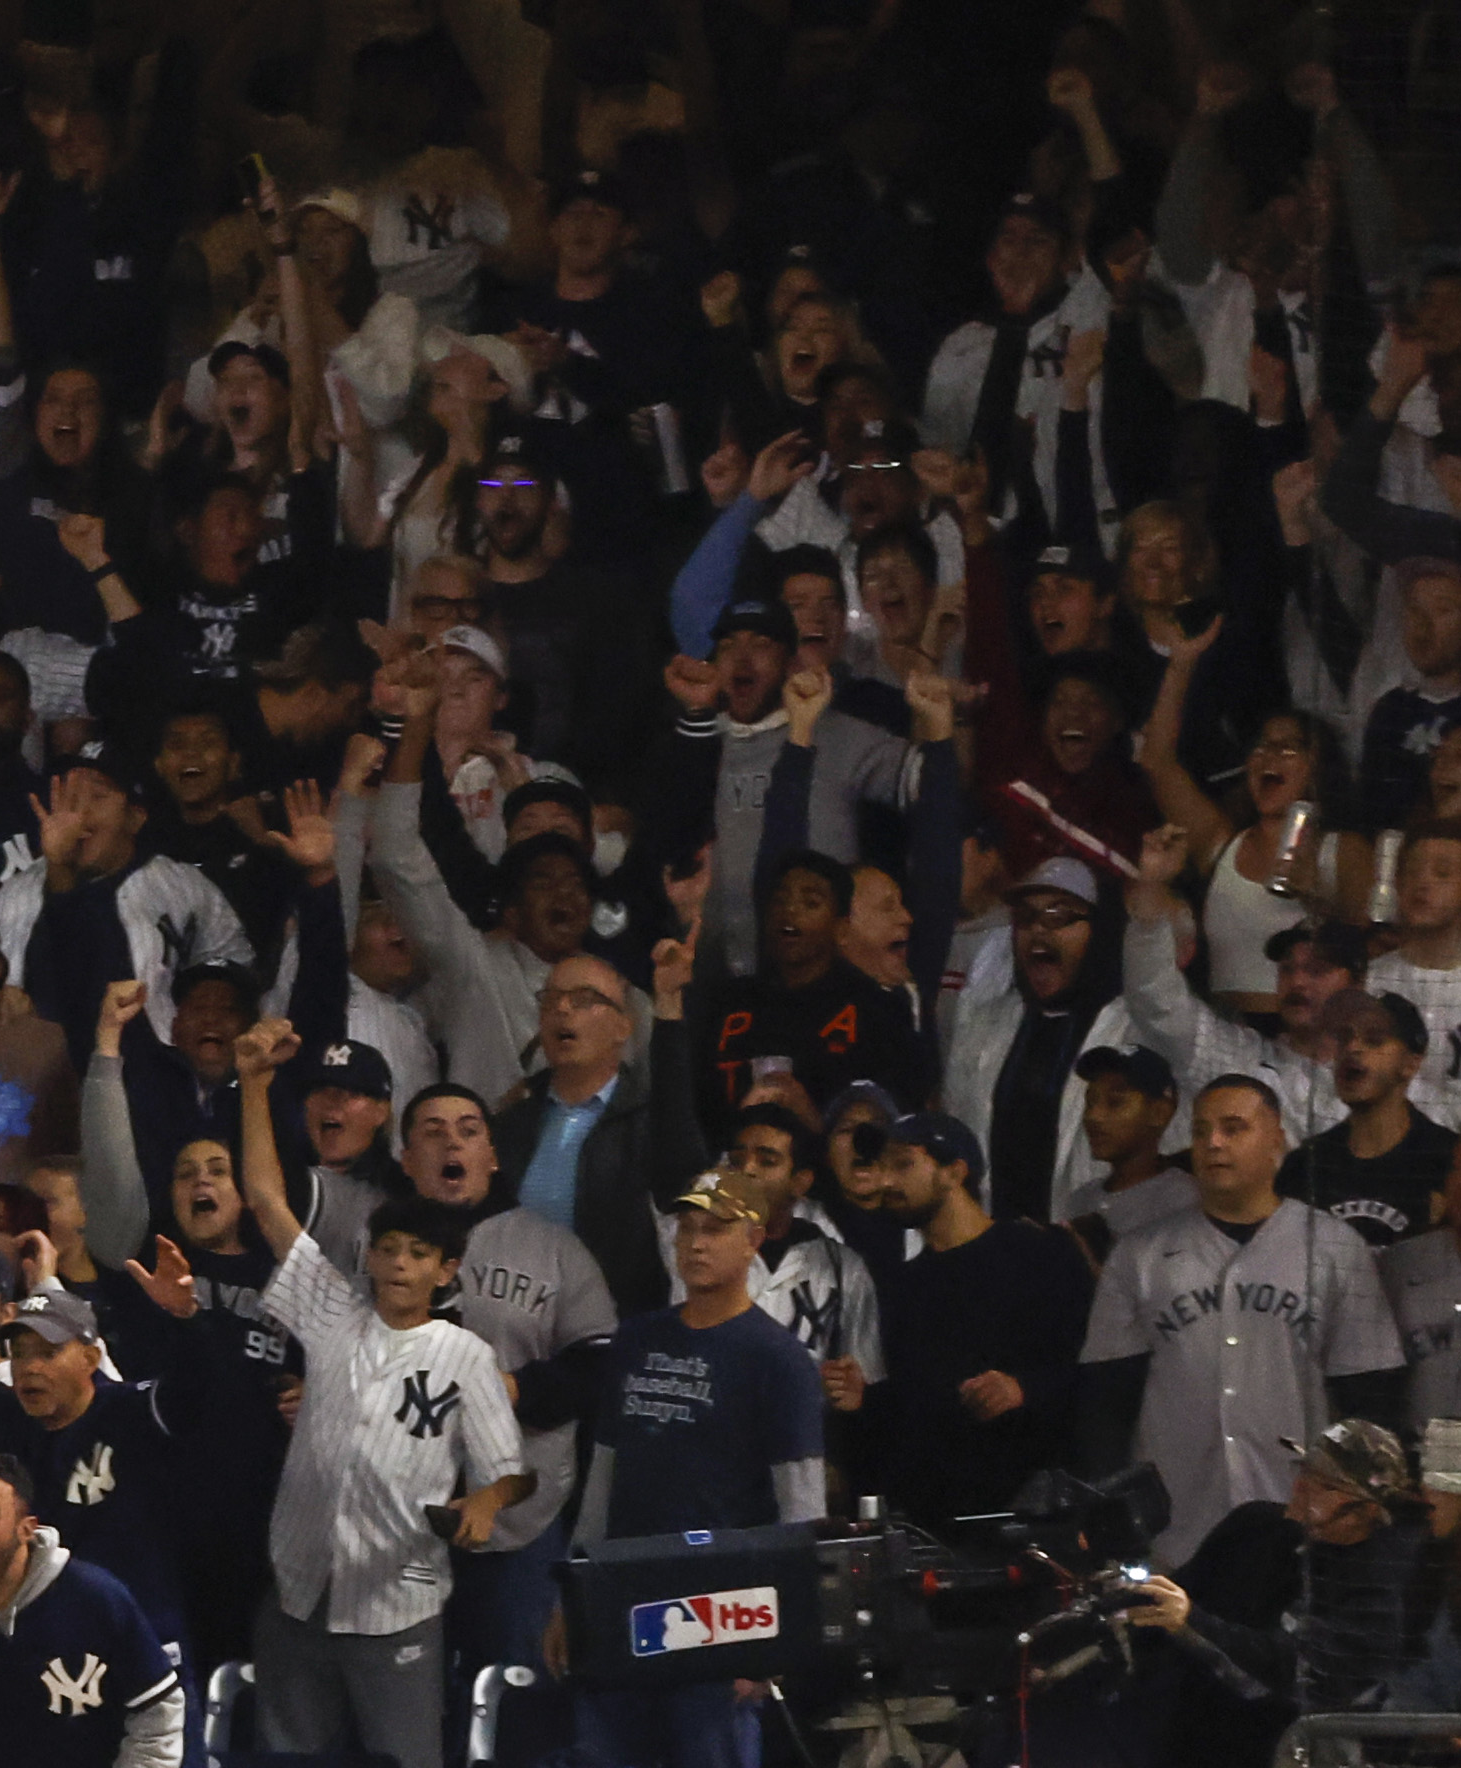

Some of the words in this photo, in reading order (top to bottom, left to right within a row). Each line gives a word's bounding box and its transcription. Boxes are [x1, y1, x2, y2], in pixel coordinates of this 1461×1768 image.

[470, 1265, 558, 1316] YORK
[1153, 1284, 1221, 1341] NEW
[1235, 1282, 1318, 1334] YORK
[397, 1369, 458, 1438] NY
[42, 1653, 107, 1717] NY
